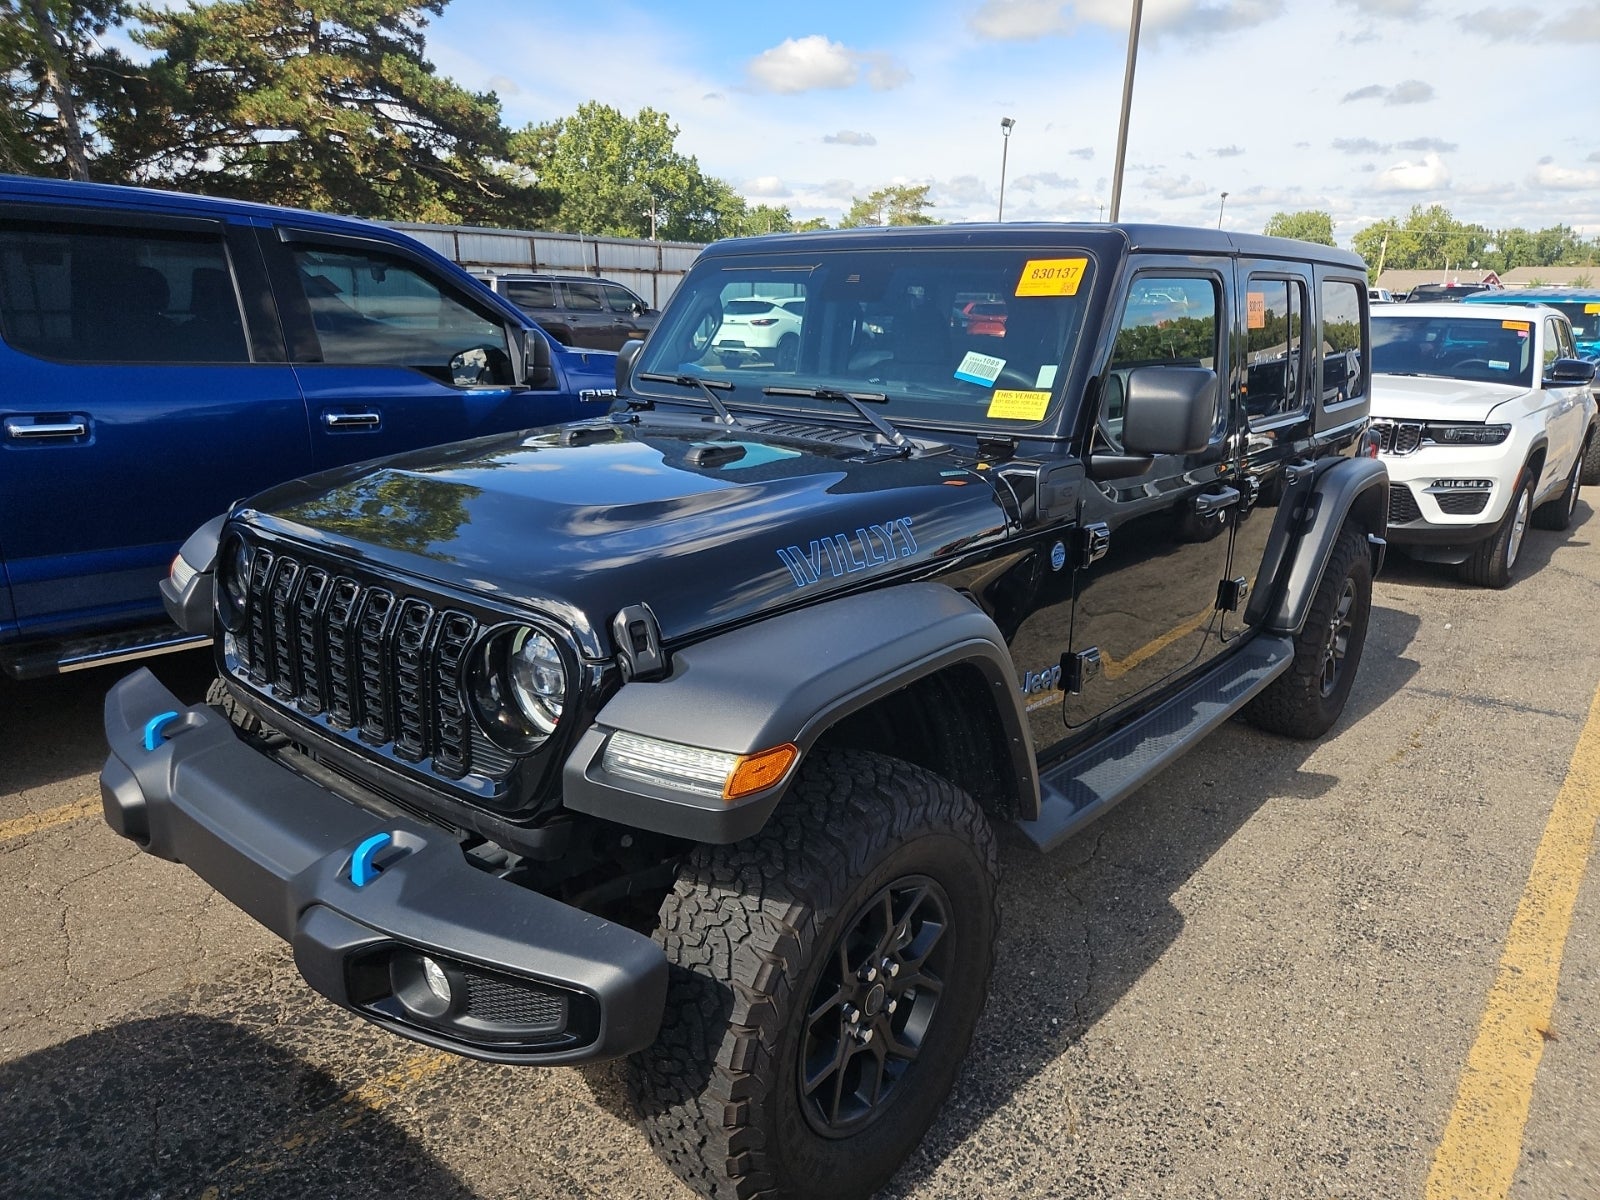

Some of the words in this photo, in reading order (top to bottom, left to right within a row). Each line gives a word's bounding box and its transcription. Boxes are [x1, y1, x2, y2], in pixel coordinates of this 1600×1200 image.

[1032, 267, 1079, 279] 830137
[777, 517, 918, 587] WILLYS
[1023, 664, 1061, 693] Jeep
